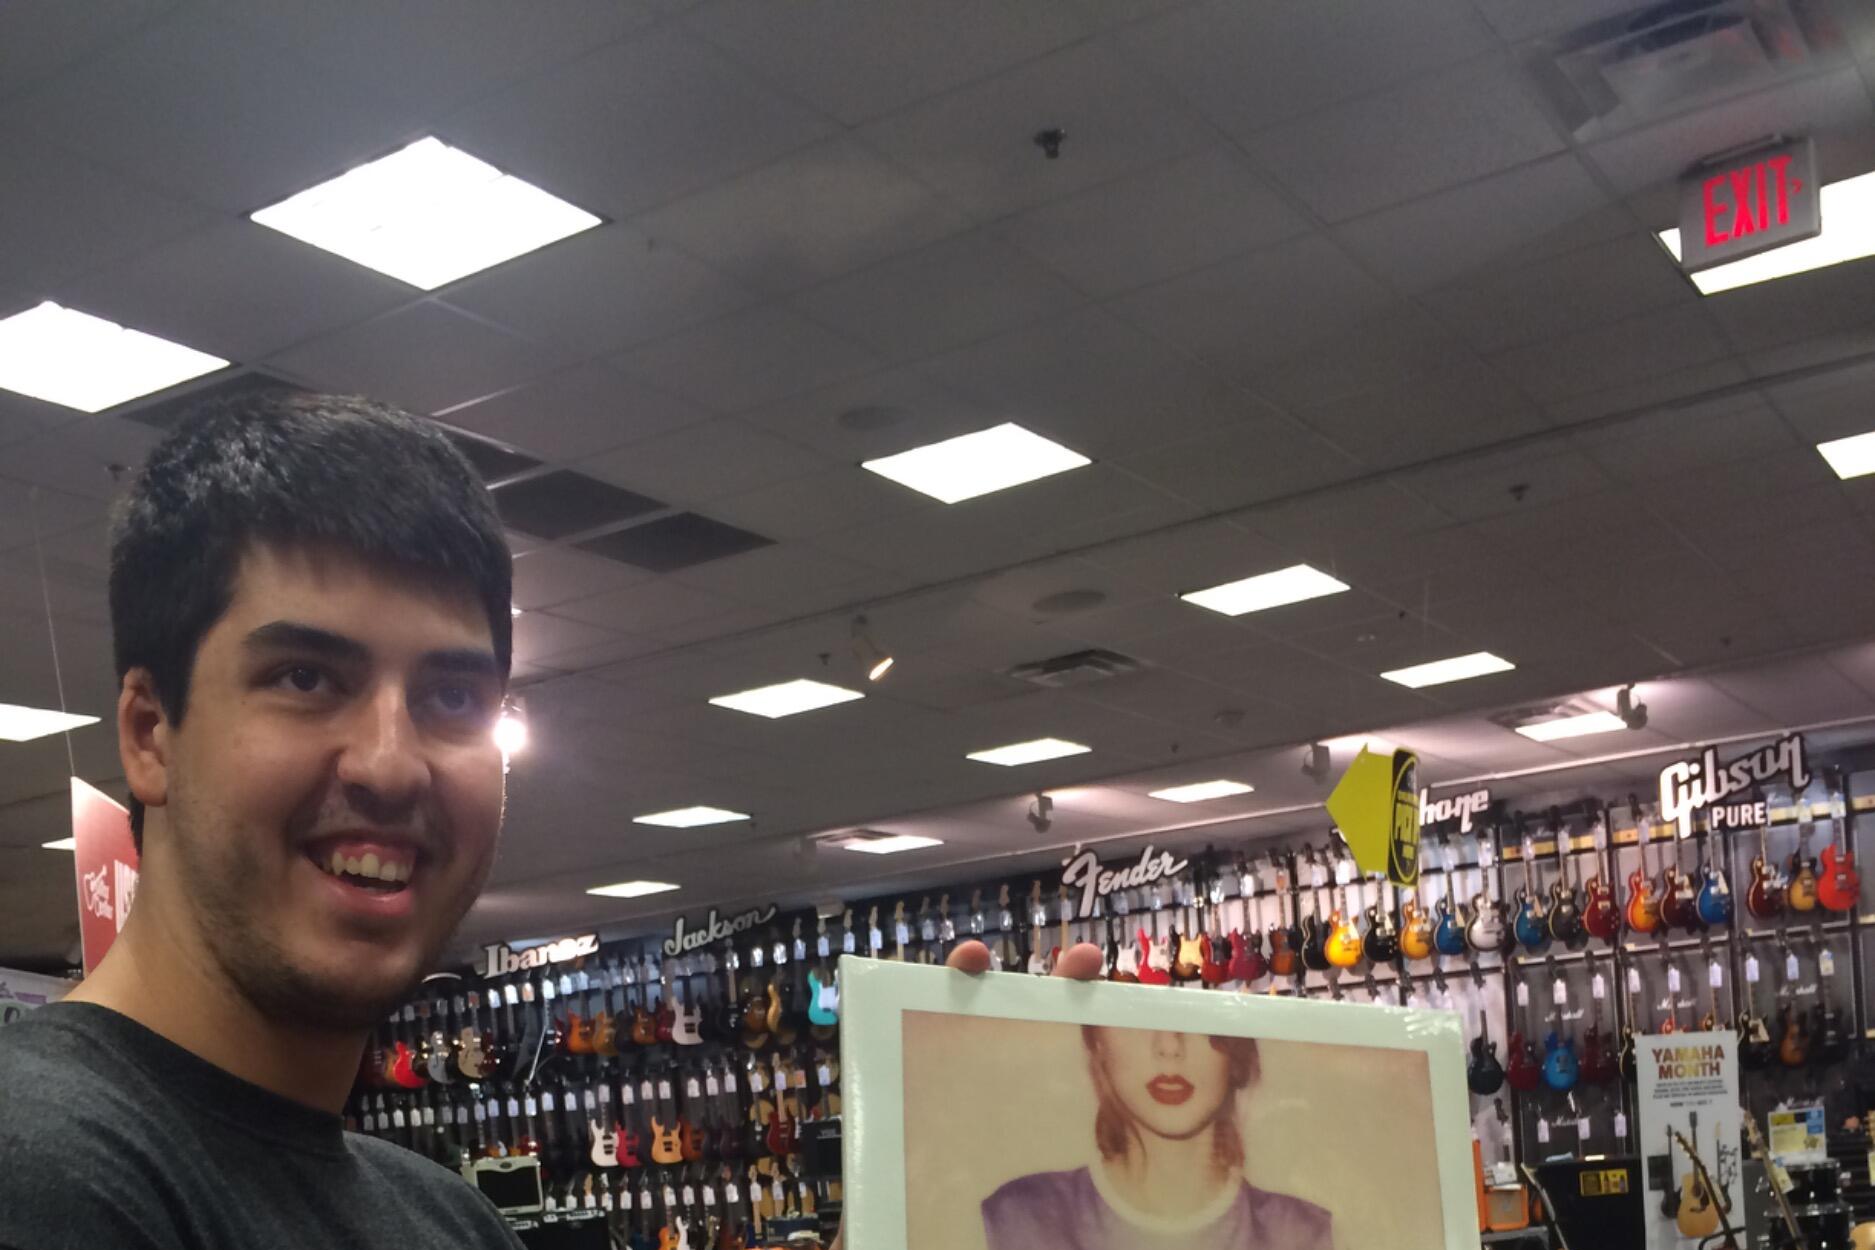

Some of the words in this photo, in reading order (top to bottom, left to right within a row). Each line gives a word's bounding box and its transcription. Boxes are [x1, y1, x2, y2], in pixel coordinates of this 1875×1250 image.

[1702, 154, 1793, 248] EXIT
[1420, 787, 1490, 834] hone
[1660, 736, 1810, 840] Gibson
[1711, 801, 1768, 829] PURE
[1062, 845, 1189, 918] Fender
[664, 903, 777, 956] Jackson
[484, 934, 599, 978] Ibanez
[1652, 1044, 1725, 1064] YAMAHA
[1657, 1061, 1722, 1081] MONTH
